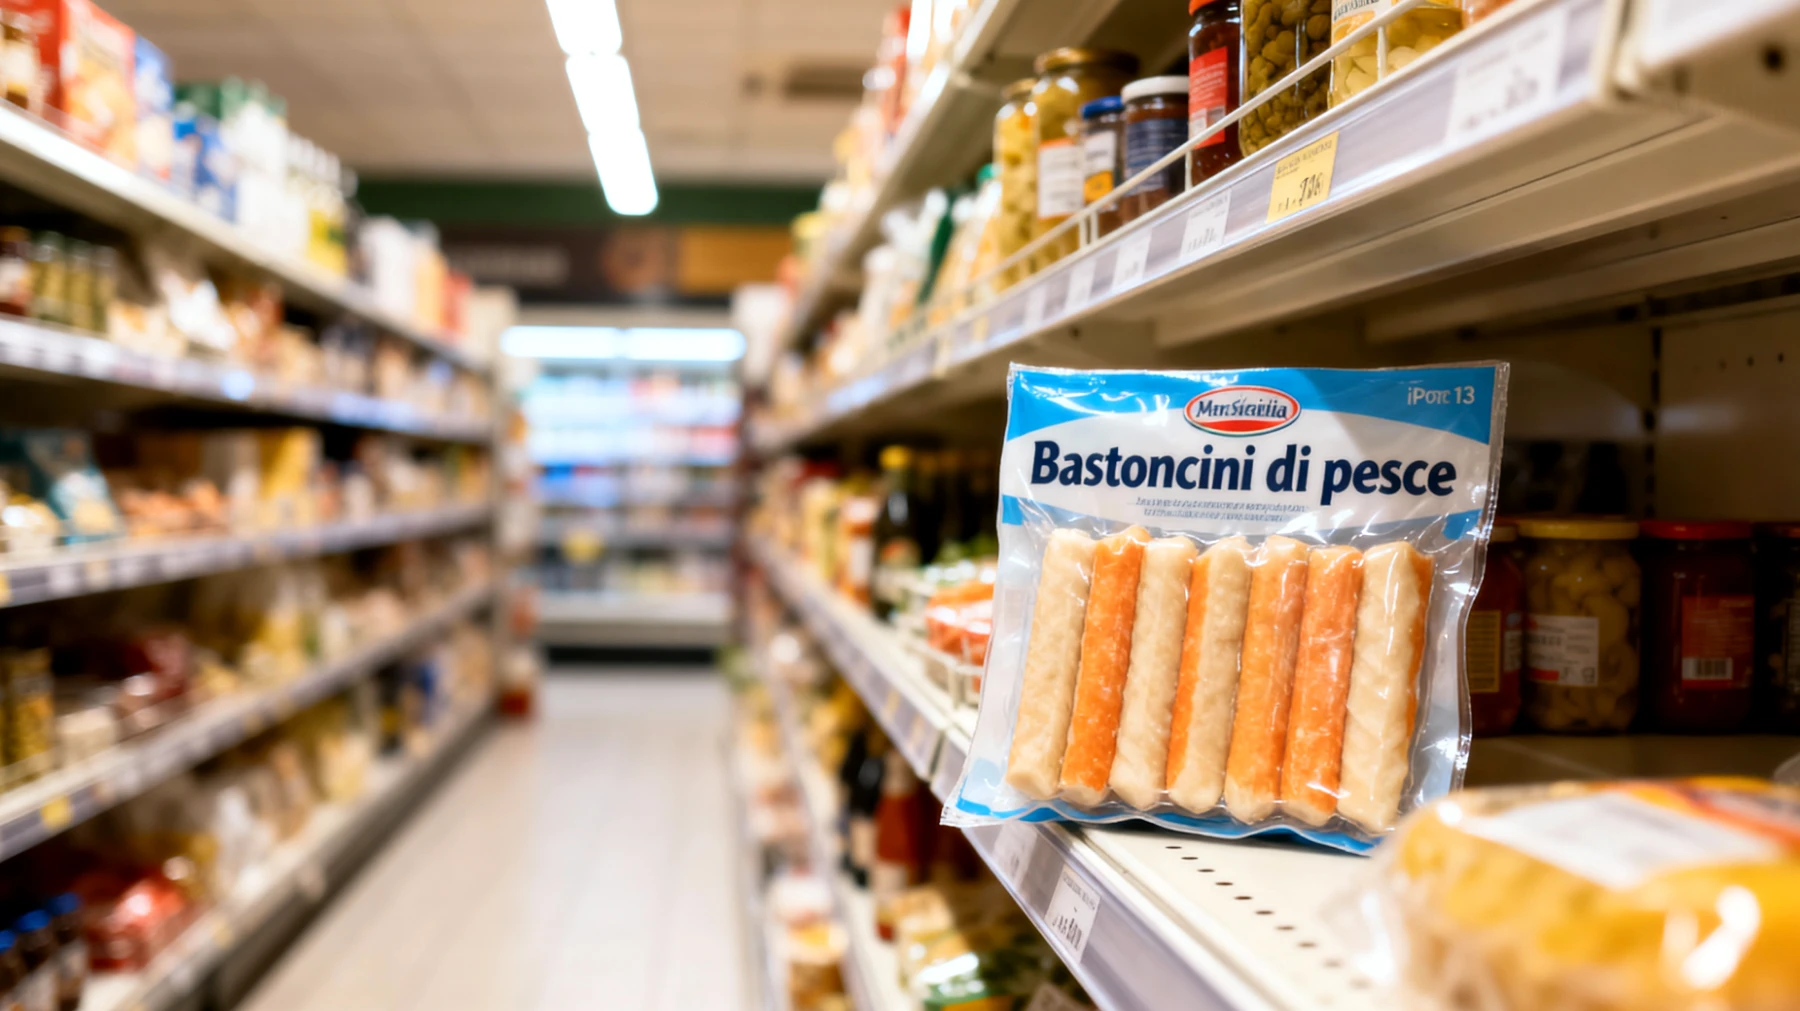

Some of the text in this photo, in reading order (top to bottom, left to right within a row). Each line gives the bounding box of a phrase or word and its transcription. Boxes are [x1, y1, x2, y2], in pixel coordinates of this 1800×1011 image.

[1453, 385, 1475, 405] 13
[1031, 441, 1457, 506] Bastoncini di pesce
